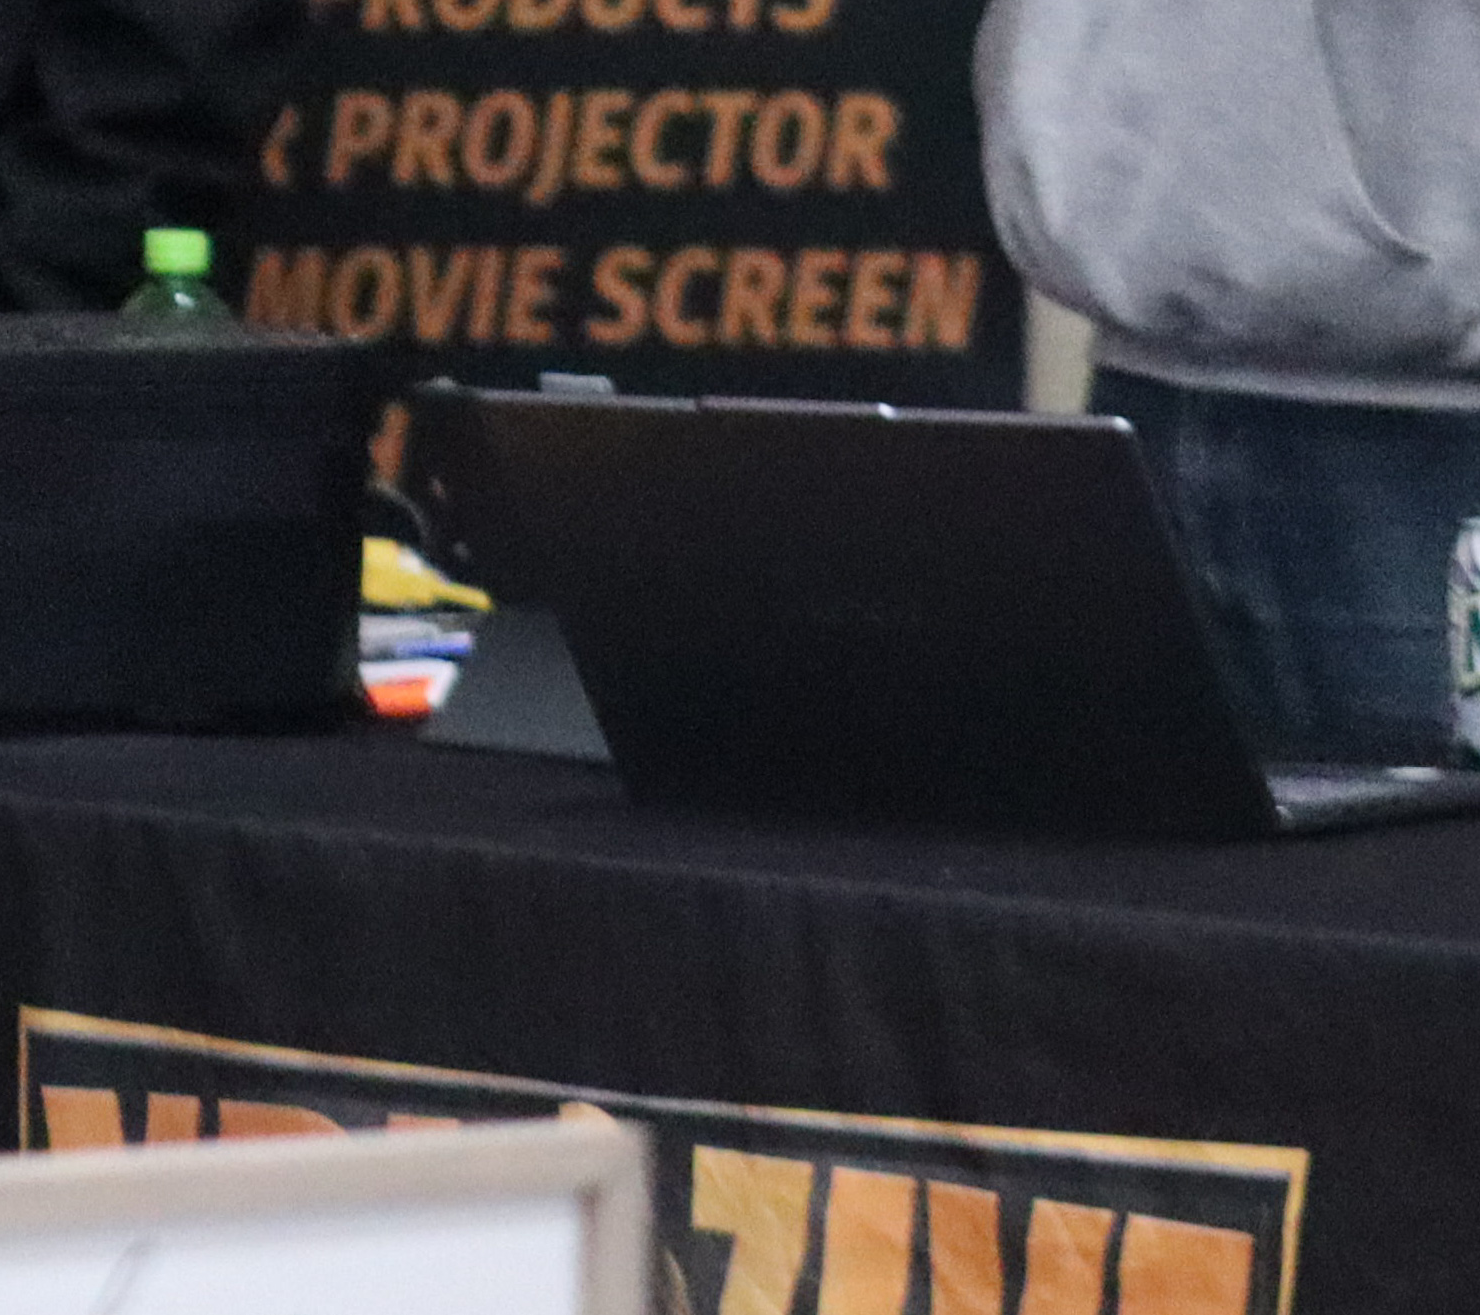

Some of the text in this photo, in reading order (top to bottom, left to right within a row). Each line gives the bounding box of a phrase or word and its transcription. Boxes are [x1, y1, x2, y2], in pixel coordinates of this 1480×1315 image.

[324, 89, 902, 205] PROJECTOR
[246, 243, 983, 351] MOVIE SCREEN
